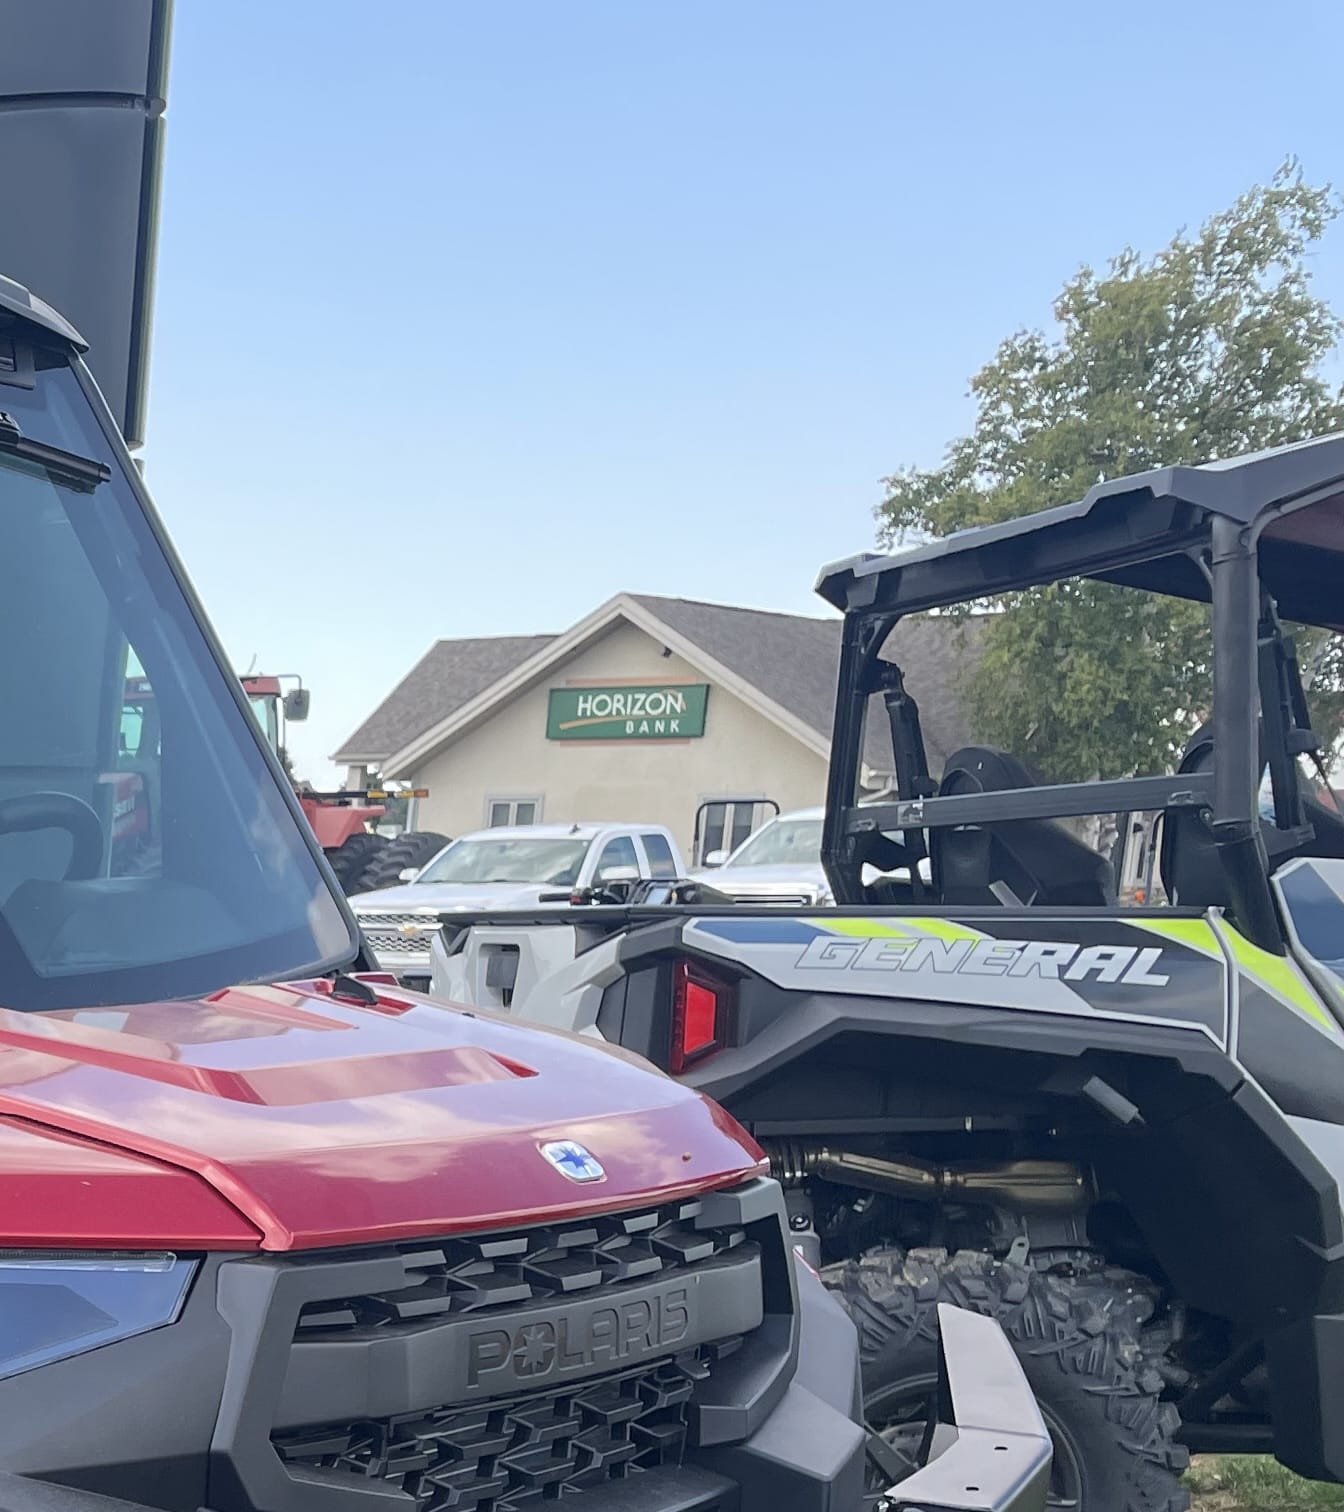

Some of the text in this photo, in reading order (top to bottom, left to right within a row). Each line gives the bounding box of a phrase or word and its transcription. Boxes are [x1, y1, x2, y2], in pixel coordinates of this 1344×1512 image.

[577, 692, 683, 717] HORIZON
[625, 720, 680, 734] BANK
[793, 936, 1171, 986] GENERAL
[466, 1288, 689, 1389] POLARIS
